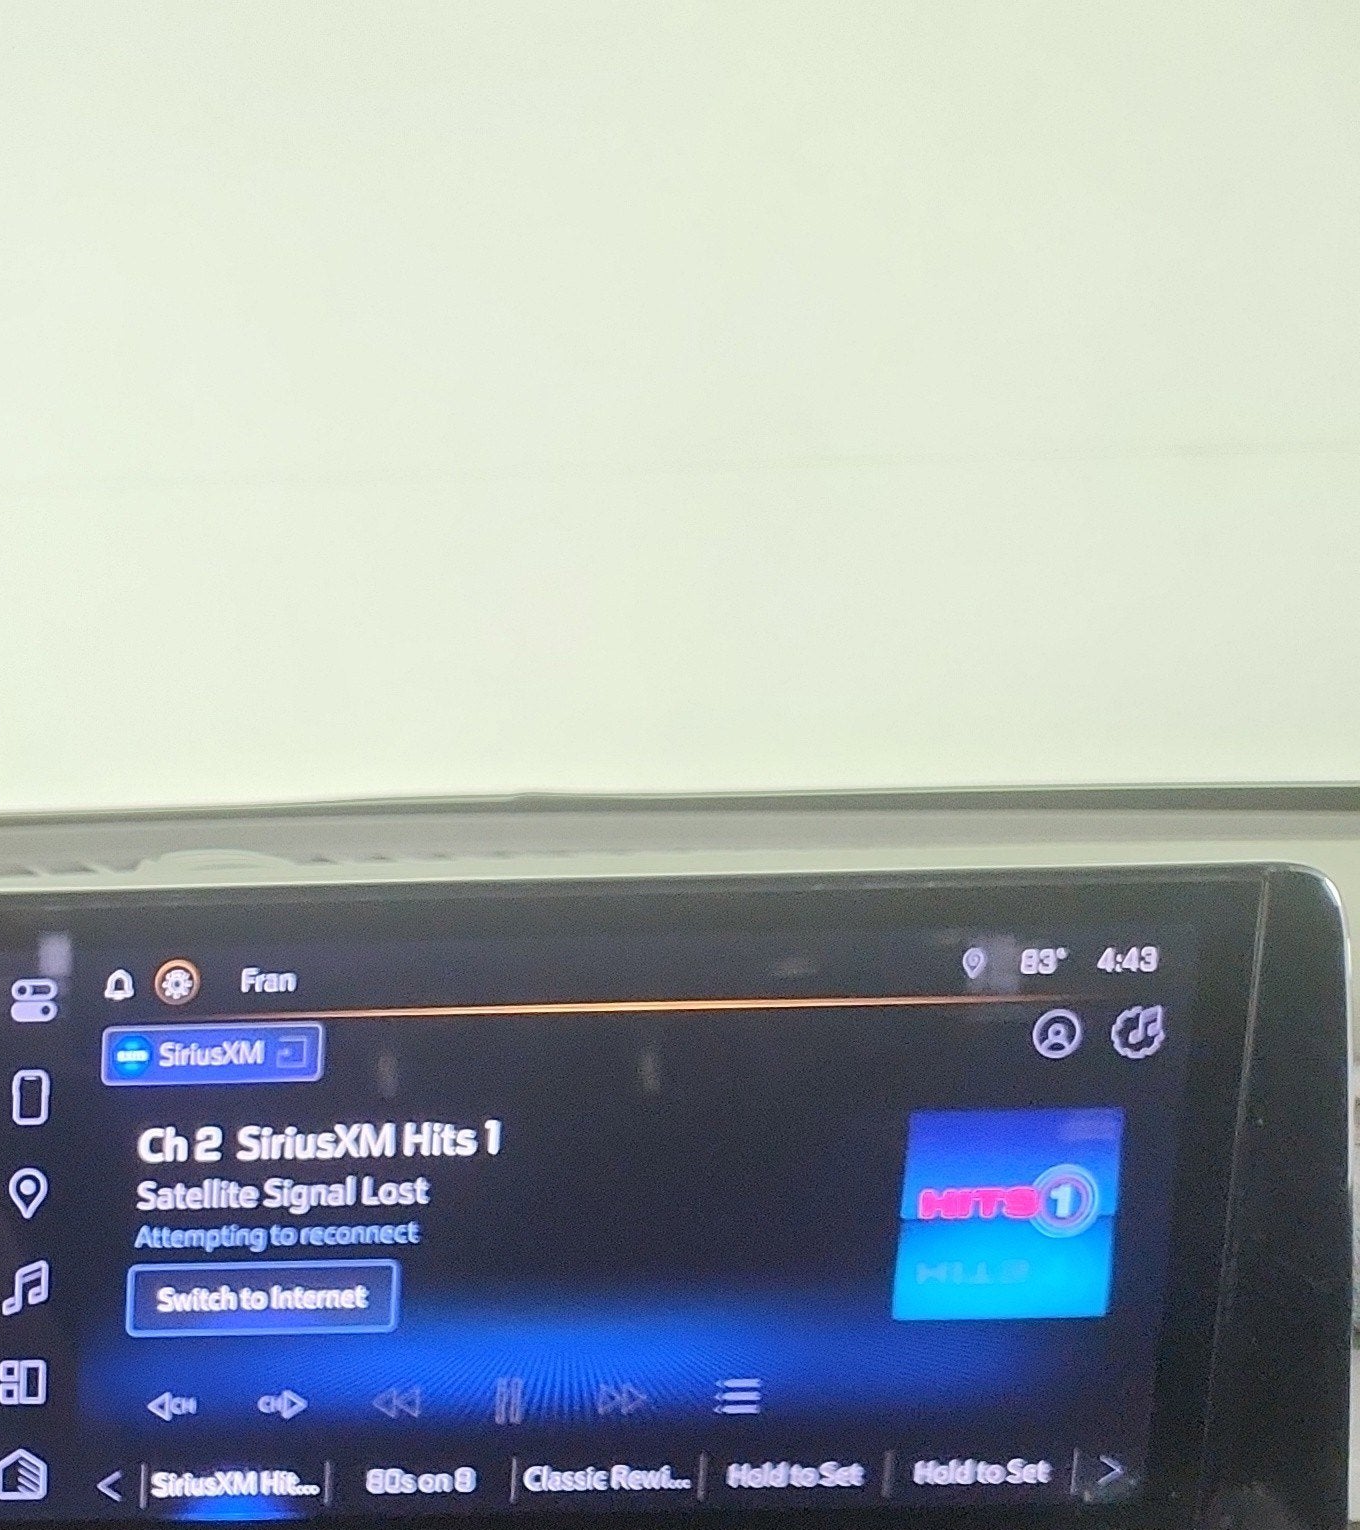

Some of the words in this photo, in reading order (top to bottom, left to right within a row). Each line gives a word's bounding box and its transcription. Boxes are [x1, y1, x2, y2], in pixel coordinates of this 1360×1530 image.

[1097, 946, 1159, 973] 4:43
[241, 967, 297, 994] Fran
[158, 1040, 267, 1067] SiriusXM
[137, 1126, 189, 1163] Ch
[194, 1126, 223, 1162] 2
[236, 1122, 398, 1160] SiriusXM
[402, 1121, 478, 1157] Hits
[483, 1119, 502, 1155] 1
[135, 1178, 261, 1211] Satellite
[262, 1175, 358, 1215] Signal
[361, 1176, 431, 1205] Lost
[134, 1223, 268, 1252] Attempting
[270, 1223, 299, 1246] to
[300, 1220, 422, 1246] reconnect
[156, 1285, 243, 1313] Switch
[241, 1287, 271, 1310] to
[270, 1284, 370, 1310] Internet
[151, 1471, 256, 1498] SiriusXM
[416, 1472, 453, 1494] on
[522, 1465, 609, 1491] Classic
[726, 1462, 791, 1488] Hold
[789, 1464, 820, 1488] to
[819, 1461, 866, 1487] Set
[913, 1459, 978, 1485] Hold
[976, 1460, 1007, 1485] to
[1005, 1457, 1053, 1484] Set
